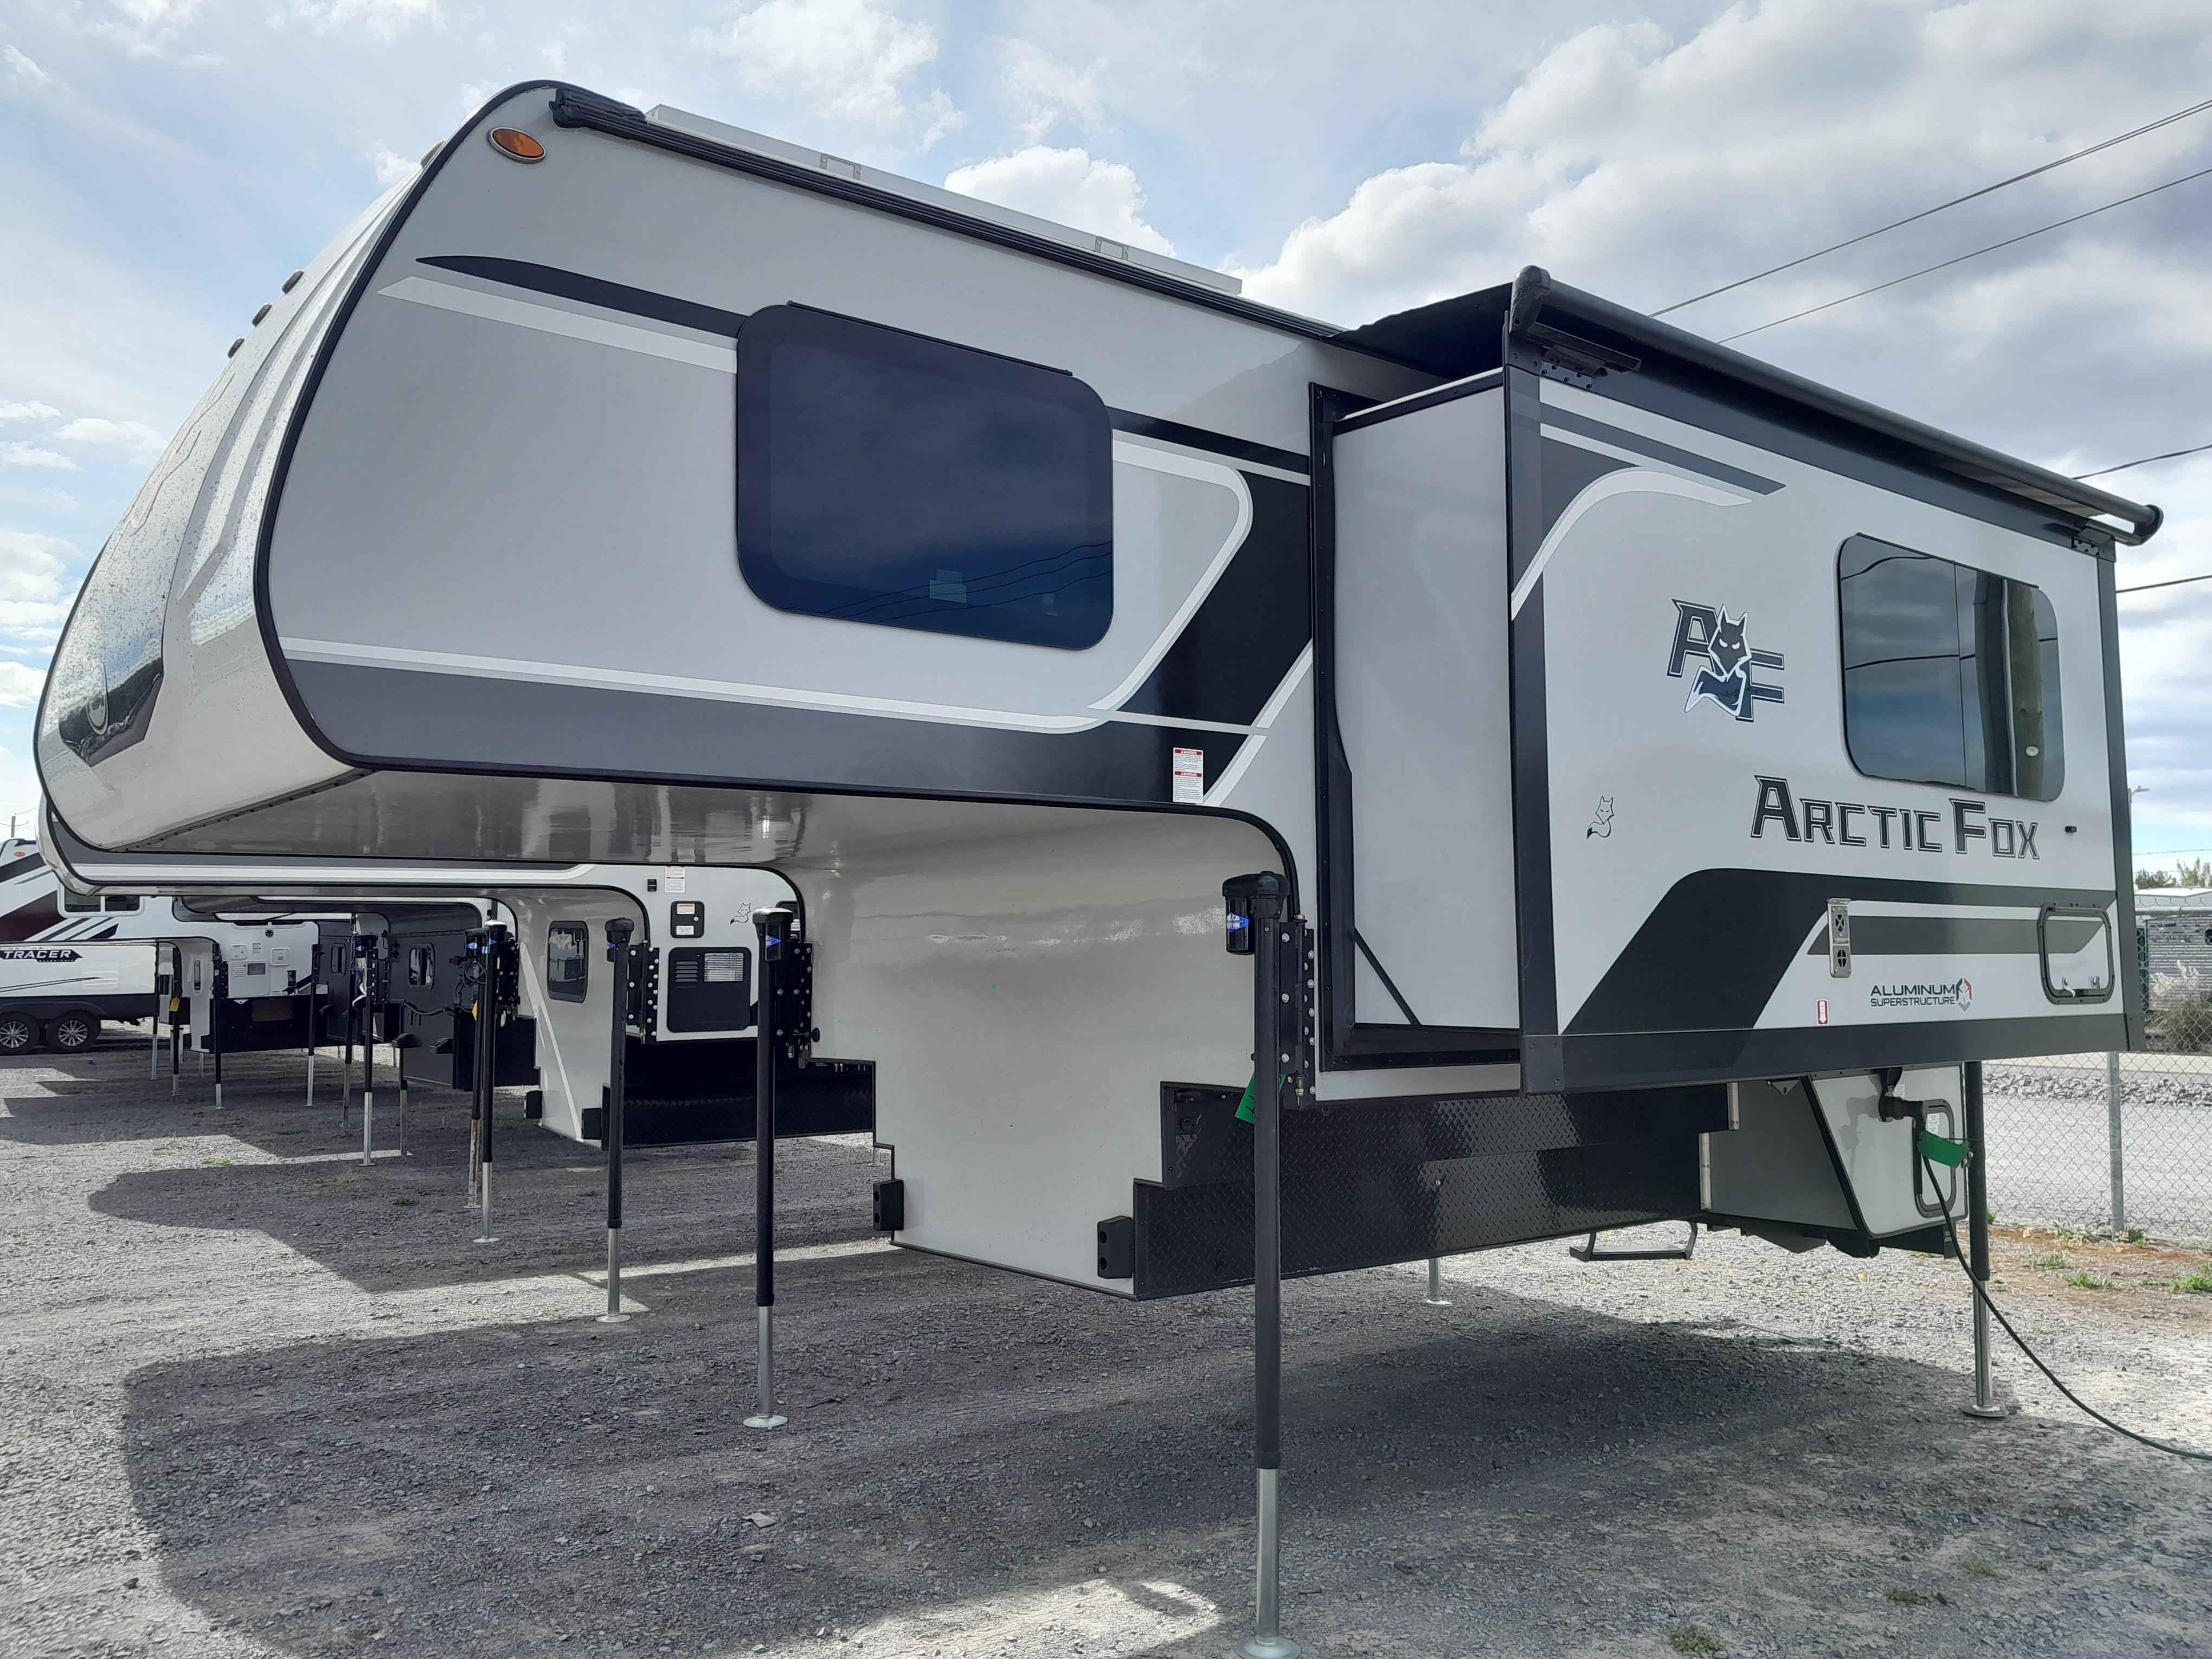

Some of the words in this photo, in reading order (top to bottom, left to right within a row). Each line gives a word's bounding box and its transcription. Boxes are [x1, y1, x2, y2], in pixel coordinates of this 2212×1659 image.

[1750, 775, 1943, 853] ARCTIC
[1948, 798, 2040, 860] FOX
[3, 950, 72, 959] TRACER
[1870, 983, 1956, 996] ALUMINUM
[1870, 996, 1956, 1007] SUPERSTRUCTURE
